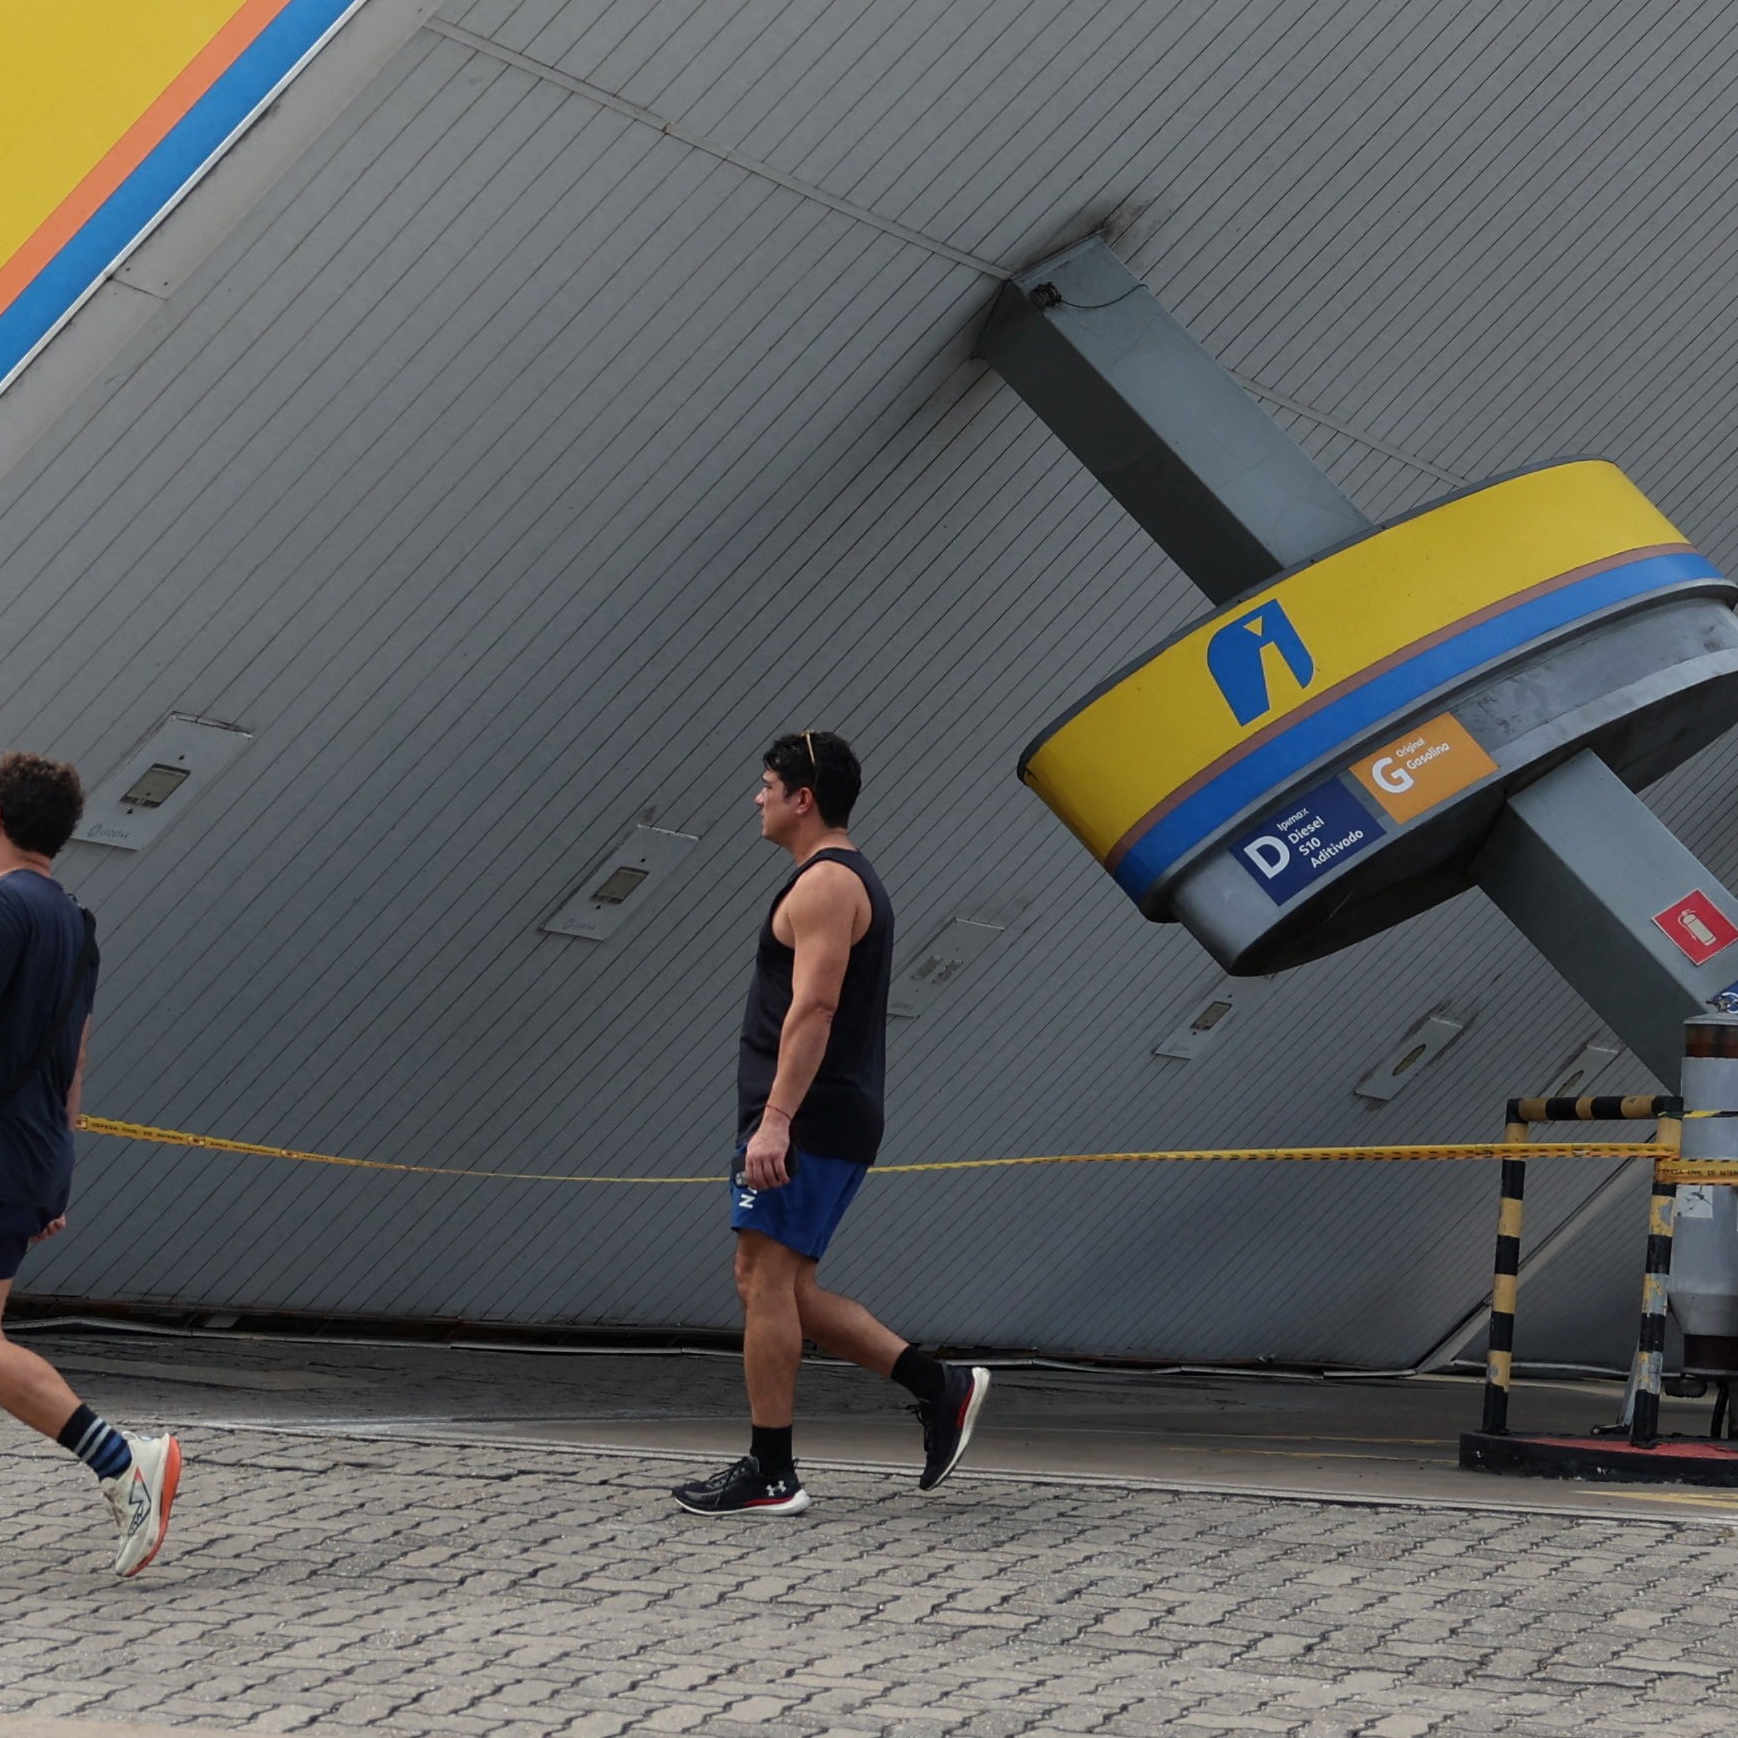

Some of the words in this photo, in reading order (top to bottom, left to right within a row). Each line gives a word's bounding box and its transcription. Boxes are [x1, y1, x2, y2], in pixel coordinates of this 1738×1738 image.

[1396, 737, 1426, 758] Original
[1406, 740, 1451, 770] Gasolina
[1371, 756, 1414, 794] G
[1276, 807, 1309, 832] Ipimax
[1288, 815, 1325, 845] Diesel
[1243, 835, 1291, 879] D
[1299, 836, 1322, 856] S10
[1310, 828, 1364, 869] Aditivado
